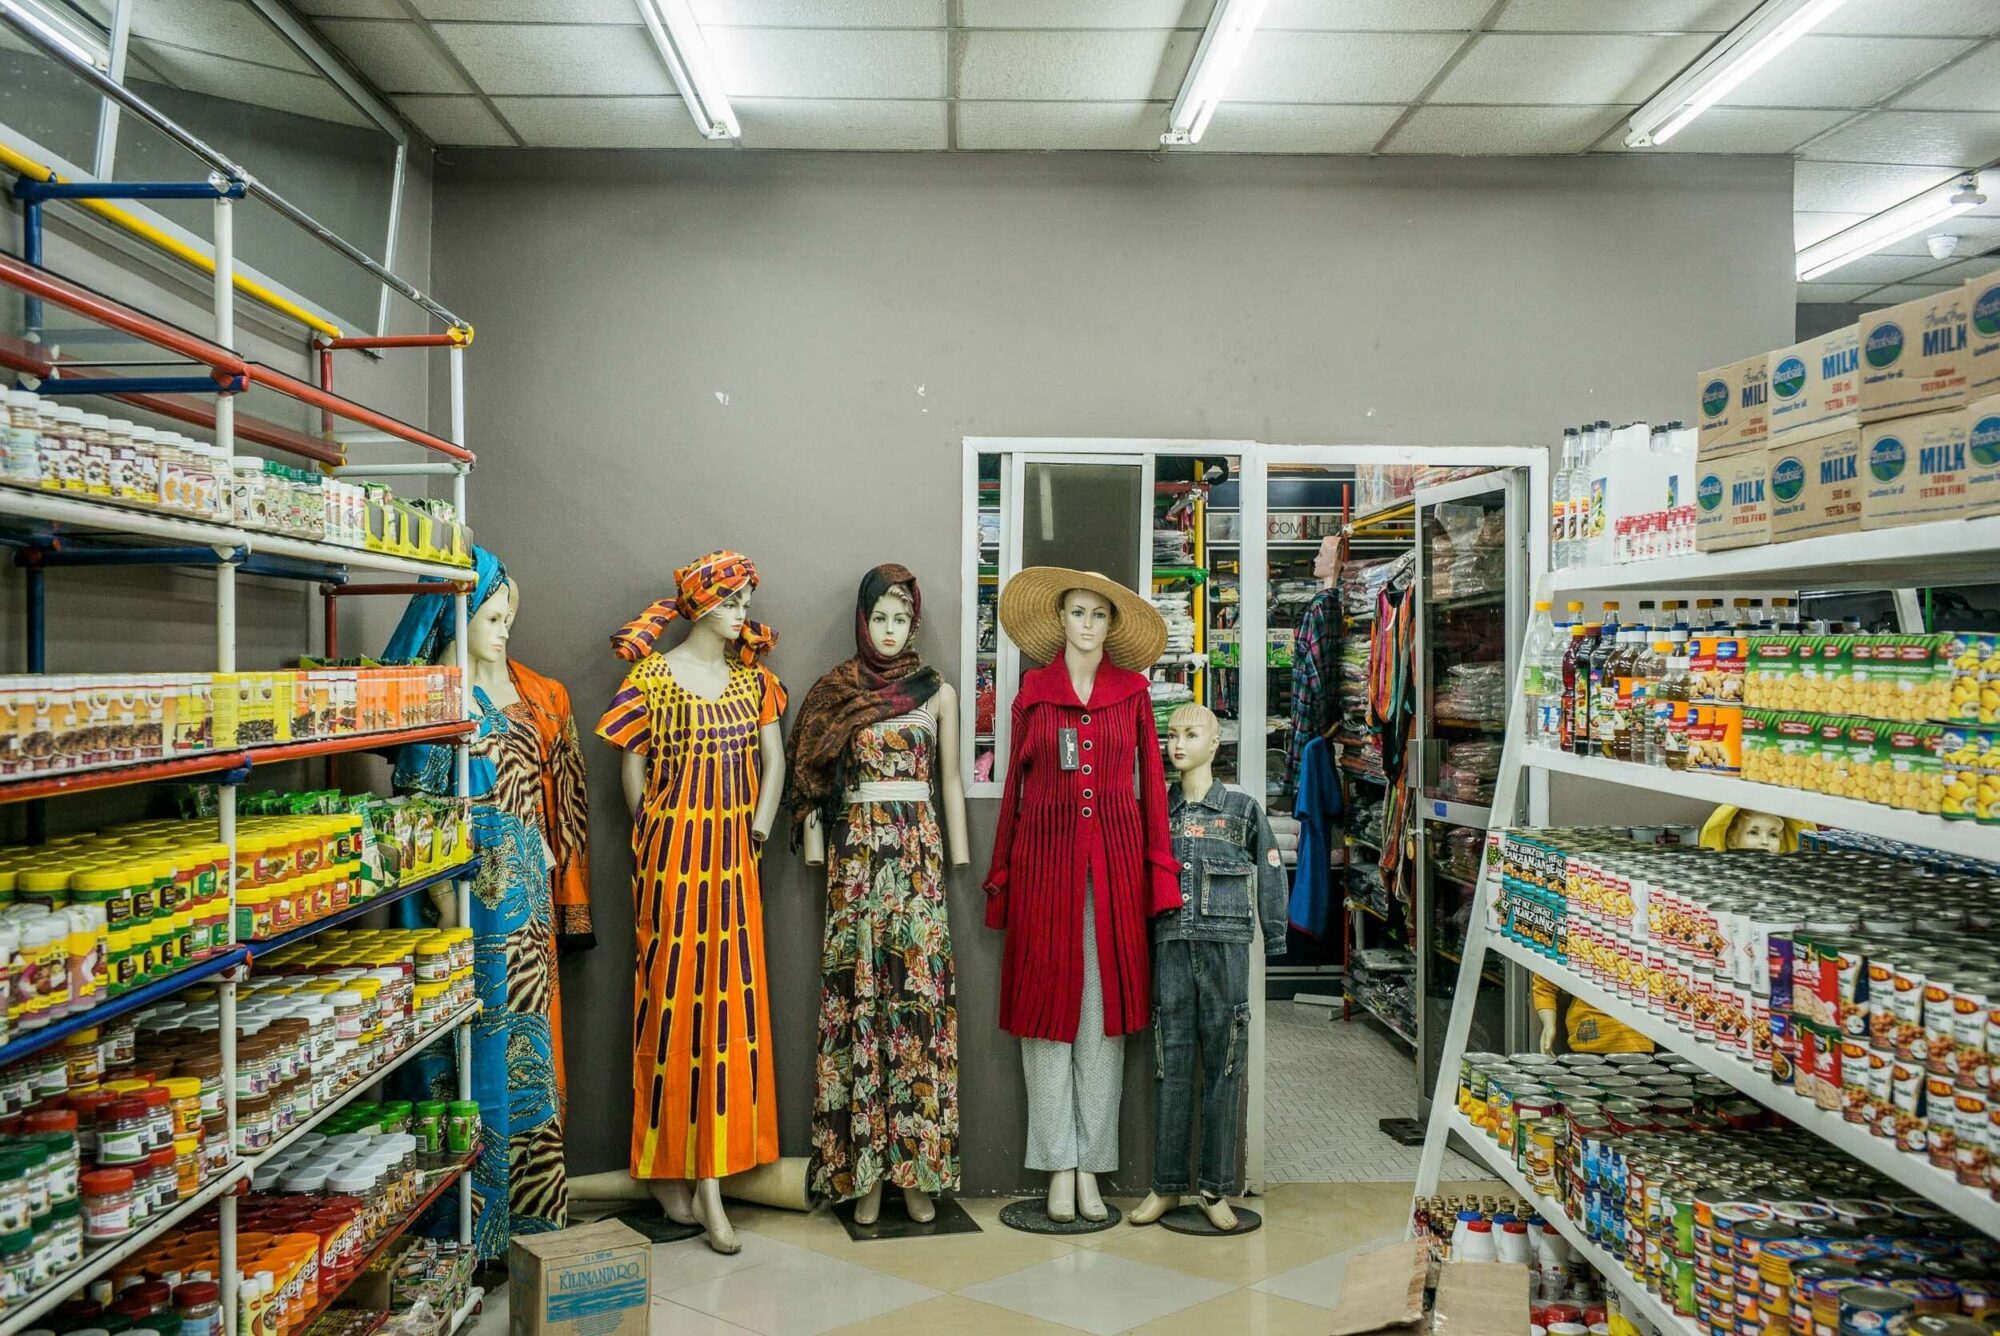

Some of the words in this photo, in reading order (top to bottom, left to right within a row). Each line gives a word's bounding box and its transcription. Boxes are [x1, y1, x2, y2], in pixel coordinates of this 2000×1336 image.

[1923, 323, 1967, 357] MILK
[1823, 347, 1859, 380] MILK
[1821, 454, 1858, 485] MILK
[1920, 443, 1966, 475] MILK
[1732, 479, 1765, 506] MILK
[1733, 515, 1749, 526] TETRA
[560, 1262, 639, 1290] KILIMANJARO
